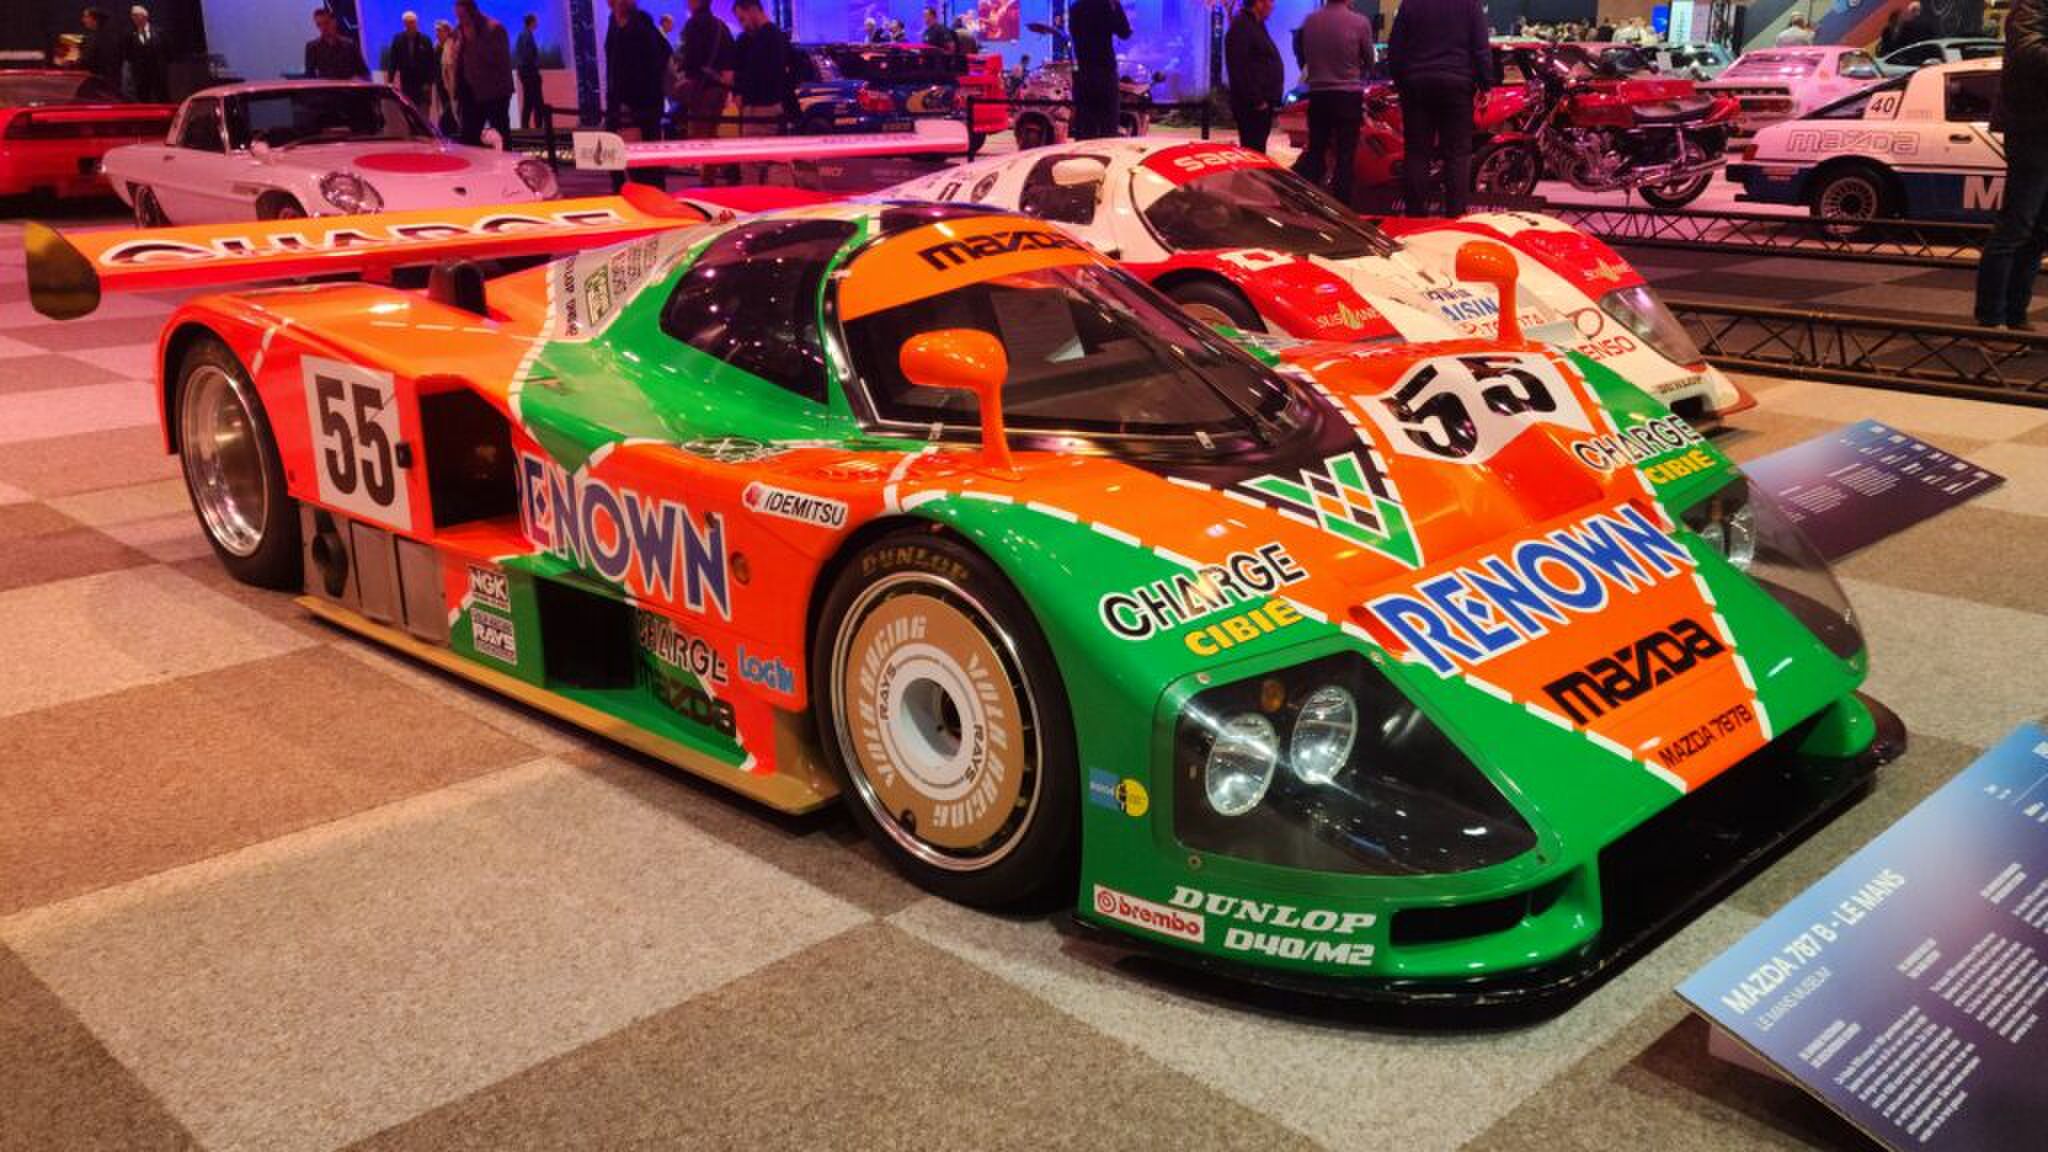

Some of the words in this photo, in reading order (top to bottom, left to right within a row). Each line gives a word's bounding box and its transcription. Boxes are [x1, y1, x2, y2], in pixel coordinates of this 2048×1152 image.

[1870, 95, 1895, 114] 40
[1577, 335, 1637, 360] ENSO
[1379, 355, 1557, 459] 55
[315, 374, 395, 507] 55
[1571, 413, 1705, 474] CHARGE
[514, 452, 732, 622] ENOWN
[765, 491, 846, 527] IDEMITSU
[471, 569, 508, 601] NGK
[863, 545, 969, 579] DUNLOP
[1099, 541, 1310, 640] CHARGE
[1365, 503, 1700, 679] RENOWN
[1184, 598, 1304, 657] CIBIE
[878, 662, 898, 721] RAYS
[1541, 618, 1727, 726] mazda
[963, 723, 984, 784] RAYS
[1657, 724, 1716, 769] MAZDA
[1708, 703, 1754, 738] 787B
[1119, 895, 1200, 937] brembo
[1168, 885, 1377, 934] DUNLOP
[1224, 927, 1375, 966] D40/M2
[1722, 956, 1799, 1015] MAZDA
[1810, 923, 1839, 944] B
[1833, 901, 1867, 926] LE
[1851, 868, 1906, 911] MANS
